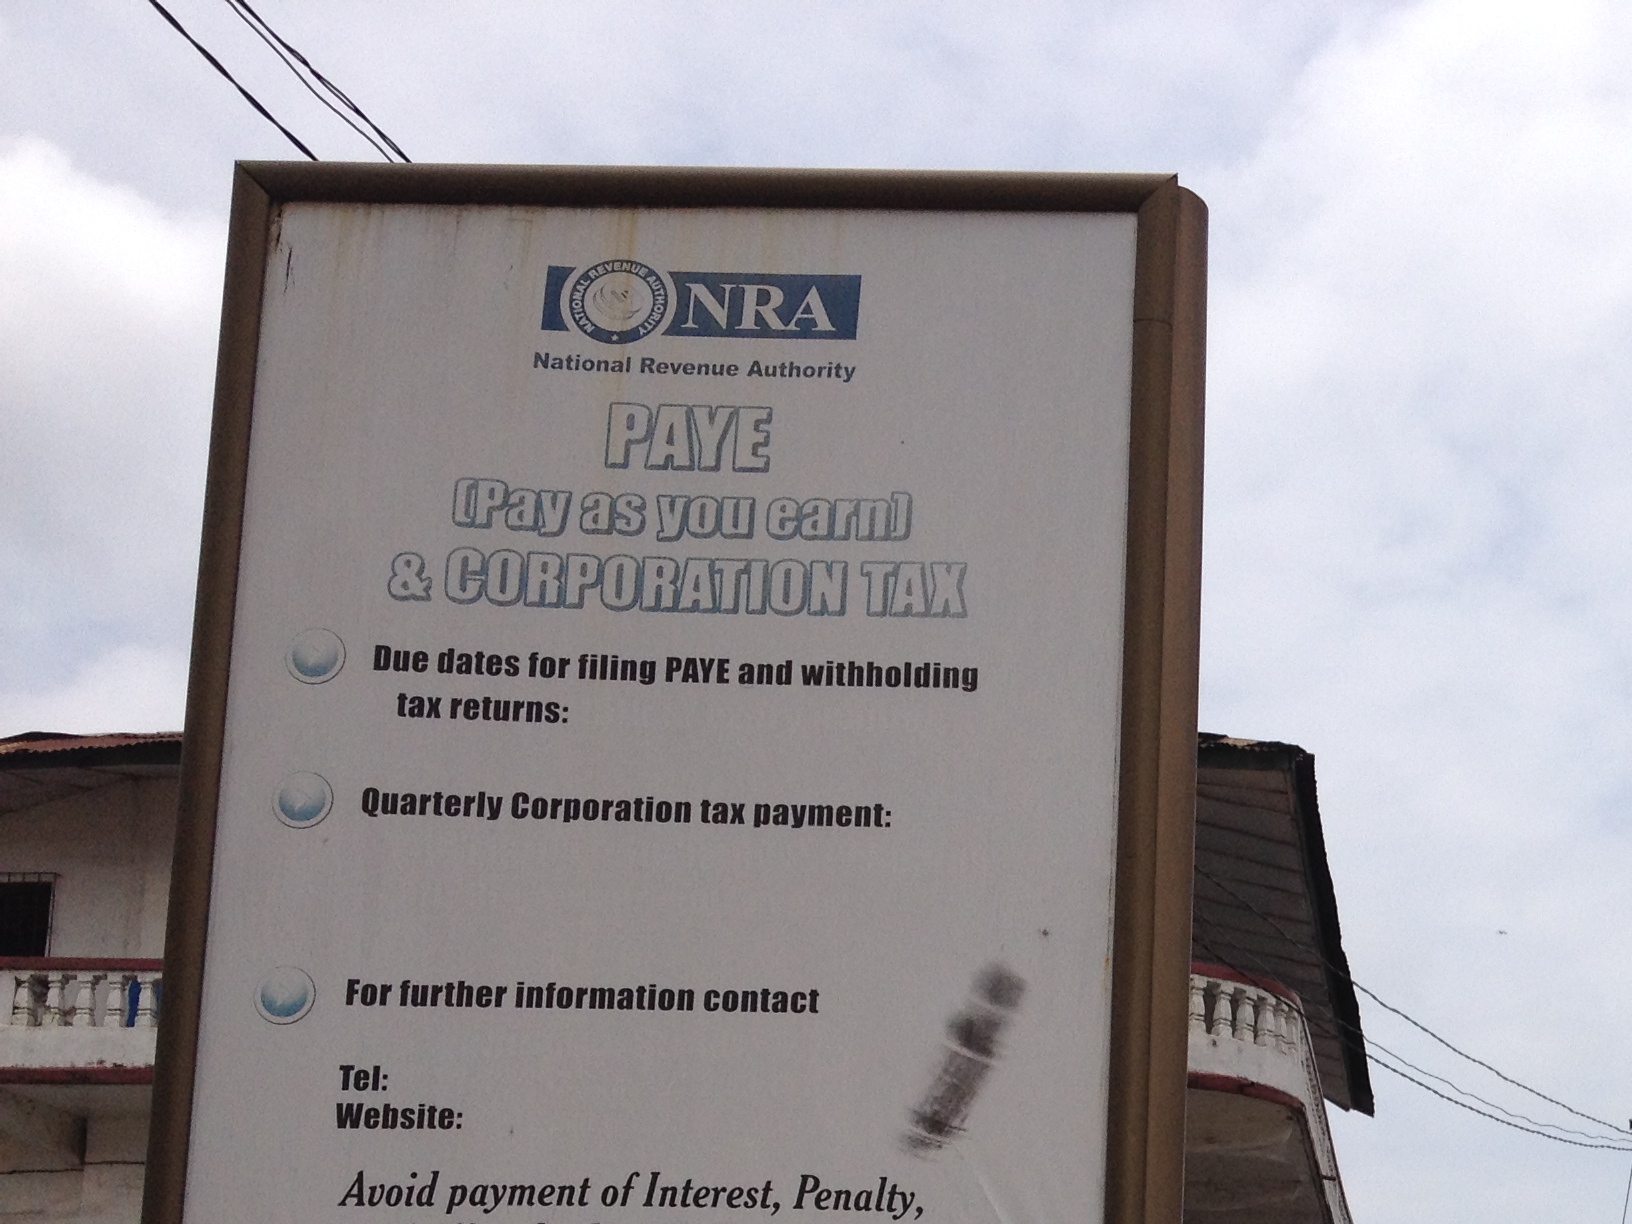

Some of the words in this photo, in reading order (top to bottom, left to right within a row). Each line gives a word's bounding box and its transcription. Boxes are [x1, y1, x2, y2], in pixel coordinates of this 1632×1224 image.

[571, 278, 596, 333] NATIONAL
[588, 261, 650, 278] REVENUE
[638, 276, 667, 335] AUTHORITY
[680, 282, 836, 332] NRA
[533, 352, 632, 373] National
[640, 356, 739, 377] Revenue
[747, 360, 856, 382] Authority
[604, 402, 773, 472] PAYE
[579, 492, 647, 536] as
[656, 494, 756, 542] you
[387, 552, 433, 602] &
[444, 546, 848, 616] CORPORATION
[860, 560, 968, 618] TAX
[373, 645, 429, 673] Due
[437, 647, 520, 677] dates
[528, 652, 571, 679] for
[577, 653, 656, 685] filing
[665, 657, 730, 684] PAYE
[738, 660, 793, 686] and
[800, 660, 980, 692] withholding
[397, 692, 441, 720] tax
[450, 696, 569, 724] returns:
[361, 787, 503, 821] Quarterly
[510, 792, 691, 823] Corporation
[700, 799, 746, 825] tax
[753, 802, 892, 829] payment:
[346, 978, 393, 1006] For
[399, 979, 508, 1008] further
[515, 981, 694, 1011] information
[703, 987, 819, 1013] contact
[339, 1065, 388, 1091] Tel:
[336, 1102, 463, 1130] Website:
[338, 1170, 440, 1208] Avoid
[446, 1176, 591, 1214] payment
[600, 1172, 640, 1207] of
[642, 1171, 781, 1216] Interest,
[792, 1174, 924, 1220] Penalty,
